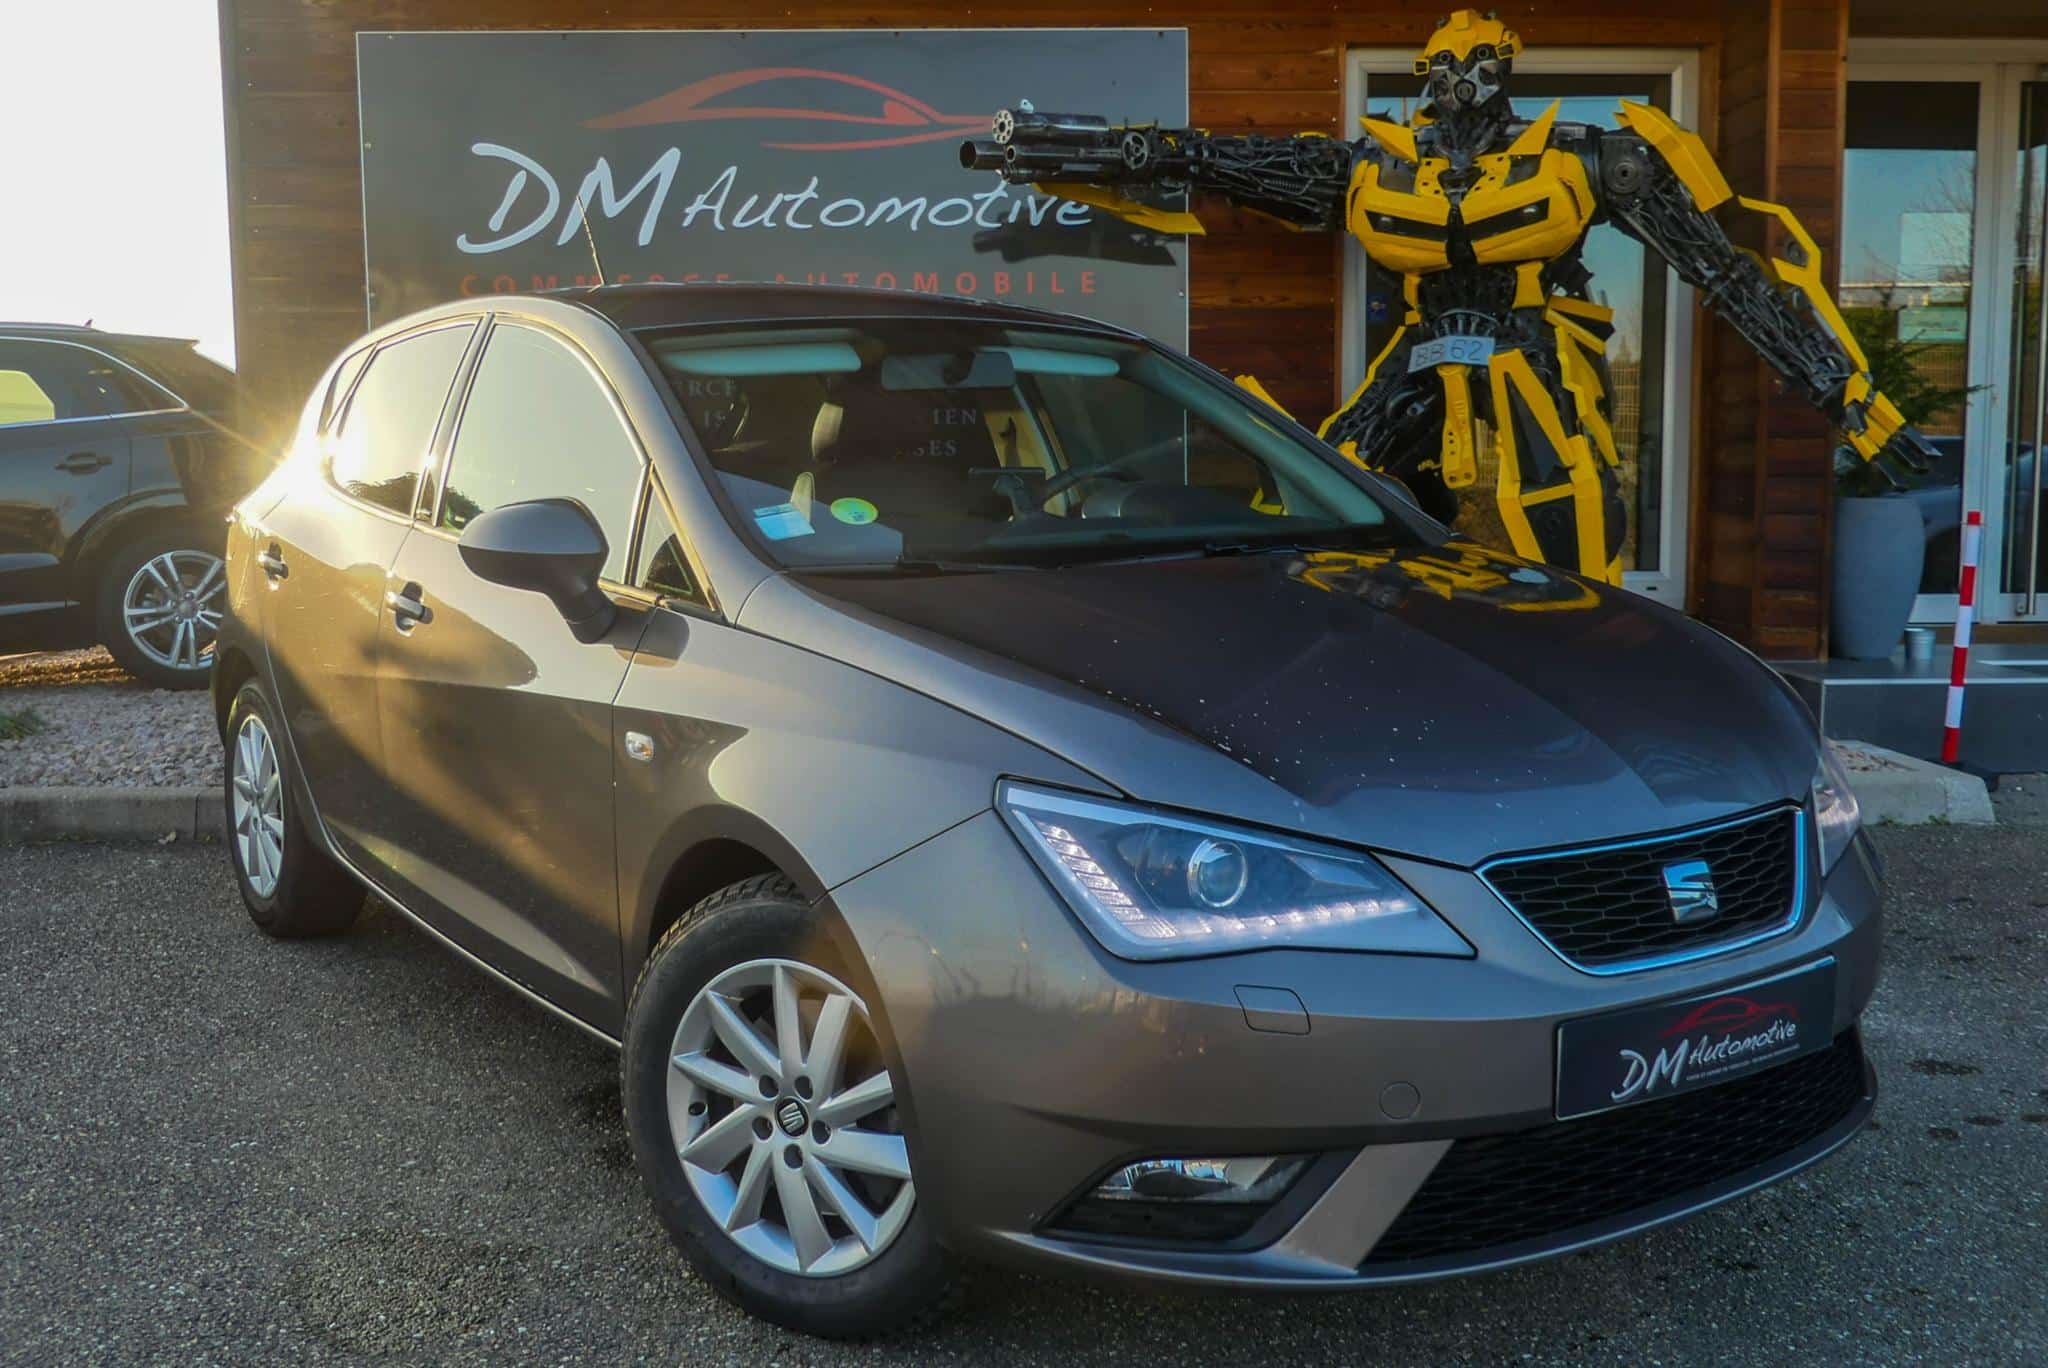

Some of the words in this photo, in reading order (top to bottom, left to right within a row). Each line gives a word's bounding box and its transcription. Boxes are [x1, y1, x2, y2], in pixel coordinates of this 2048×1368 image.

[456, 142, 681, 254] DM
[682, 165, 1092, 231] Automotive
[1611, 1038, 1689, 1101] DM
[1688, 1018, 1797, 1065] Automotive
